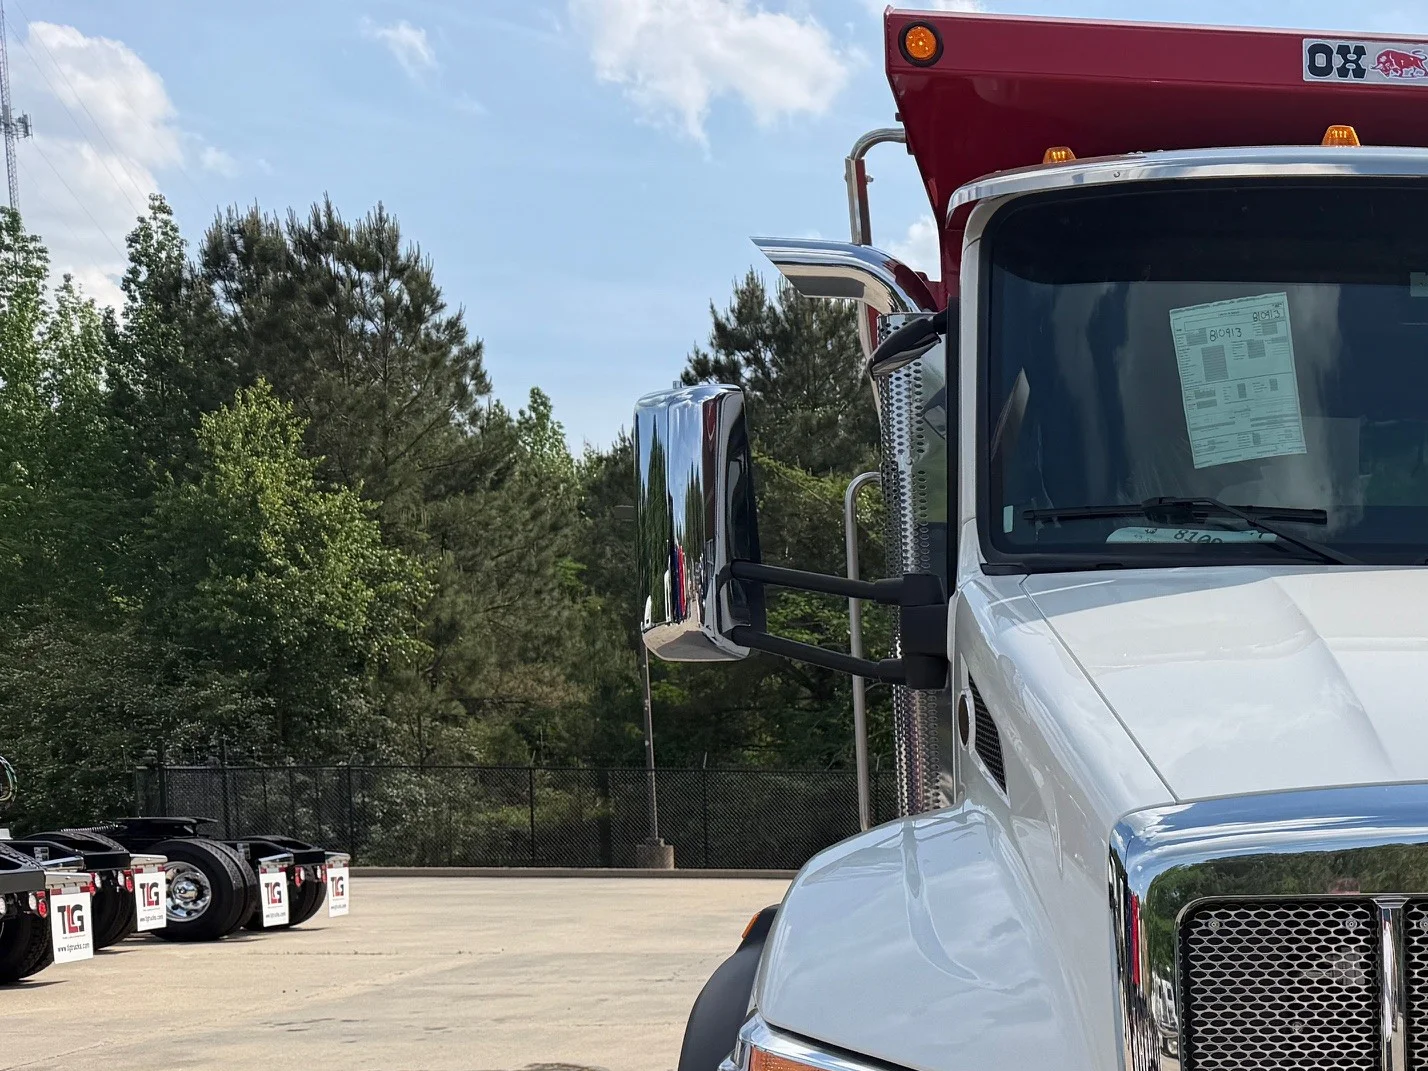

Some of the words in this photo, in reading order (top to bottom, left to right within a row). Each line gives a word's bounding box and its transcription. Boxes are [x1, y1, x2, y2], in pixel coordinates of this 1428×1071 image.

[1306, 42, 1367, 79] OX
[1252, 309, 1281, 323] 810913
[1209, 327, 1242, 342] 810913
[139, 882, 160, 908] TLG
[264, 881, 283, 905] TLG
[330, 875, 345, 898] TLG
[57, 904, 85, 935] TLG
